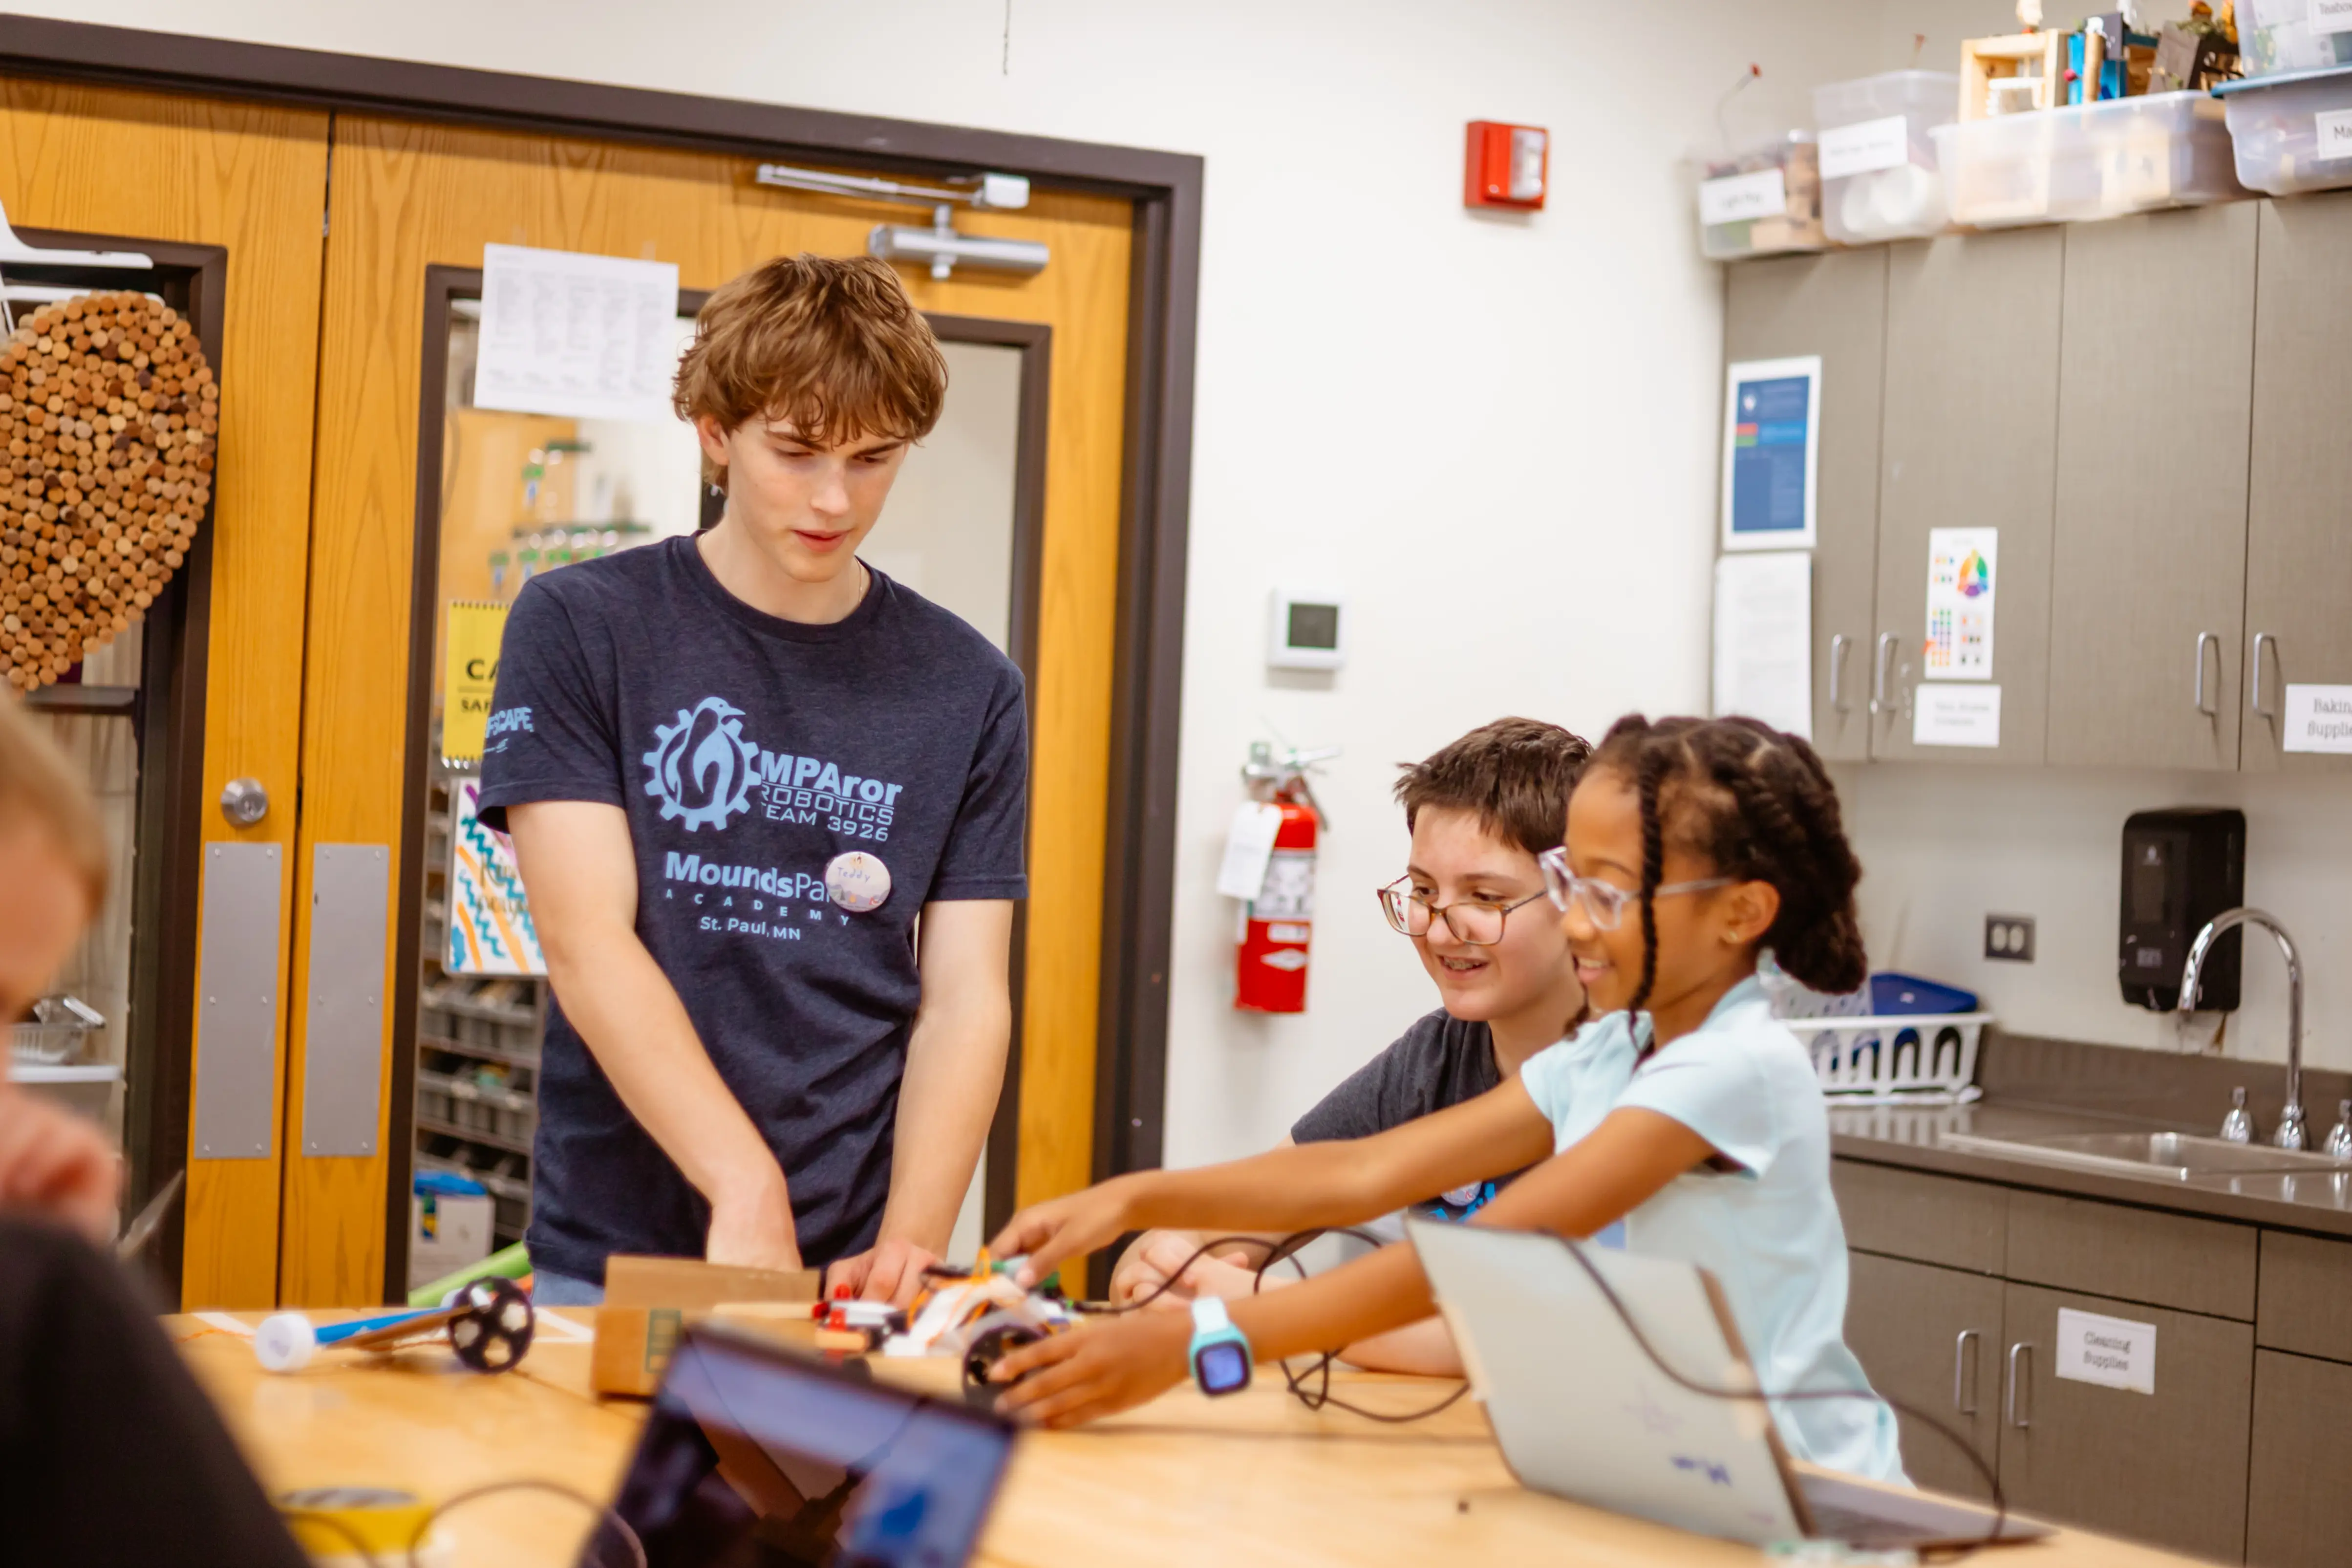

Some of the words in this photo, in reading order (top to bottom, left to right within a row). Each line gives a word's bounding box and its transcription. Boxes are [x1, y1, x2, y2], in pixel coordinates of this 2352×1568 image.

[761, 750, 903, 806] MPAror
[761, 785, 894, 826] ROBOTICS
[761, 802, 817, 825] EAM
[827, 816, 888, 842] 3926
[837, 867, 871, 883] Teddy
[700, 917, 722, 930] St.
[773, 926, 801, 940] MN
